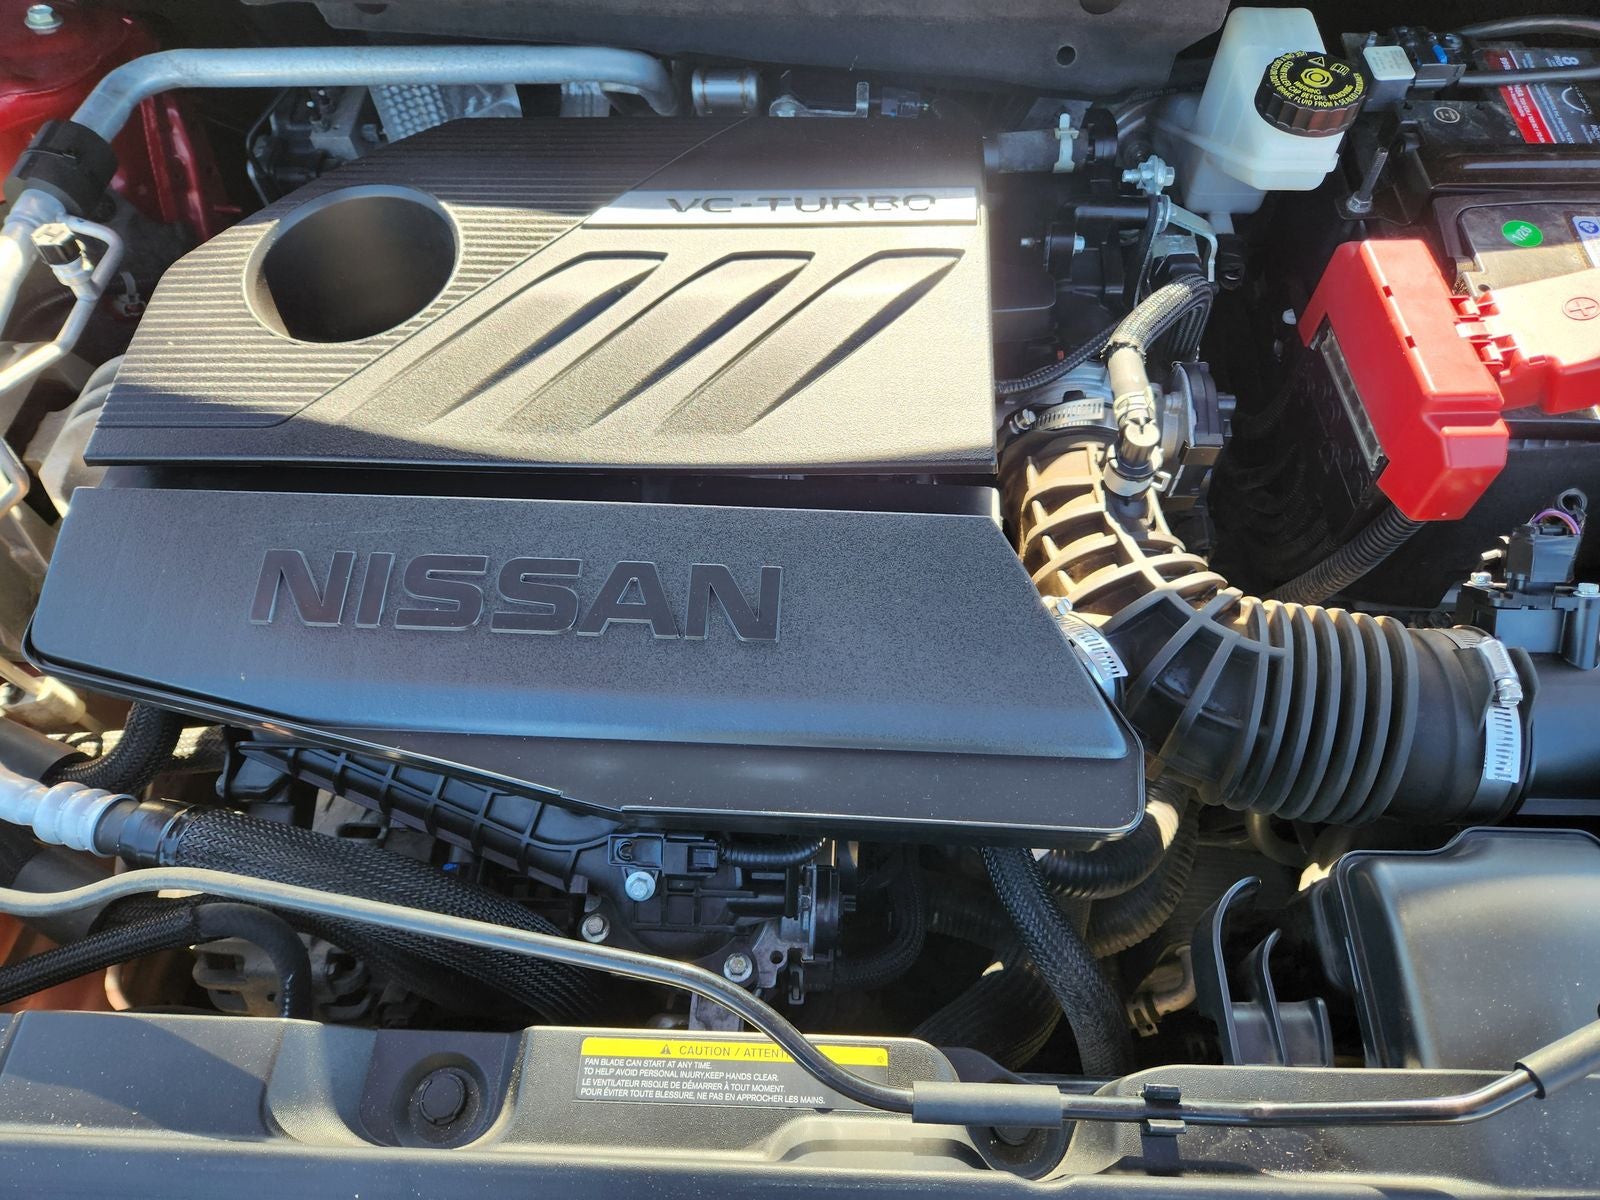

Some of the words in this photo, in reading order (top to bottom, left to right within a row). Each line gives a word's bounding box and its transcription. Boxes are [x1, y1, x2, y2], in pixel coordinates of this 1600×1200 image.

[1288, 86, 1302, 94] CAP
[1300, 91, 1328, 101] BEFORE
[1293, 80, 1321, 95] WARNING
[1293, 96, 1313, 106] FLUID
[1339, 93, 1359, 106] SEALED
[666, 195, 936, 213] VC-TURBO
[250, 548, 784, 643] NISSAN
[679, 1045, 730, 1057] CAUTION
[585, 1058, 599, 1066] FAN
[601, 1058, 624, 1066] BLADE
[626, 1059, 642, 1067] CAN
[643, 1060, 666, 1068] START
[595, 1068, 614, 1076] HELP
[639, 1069, 678, 1078] PERSONAL
[593, 1079, 640, 1087] VENTILATEUR
[641, 1080, 669, 1088] RISQUE
[682, 1081, 722, 1090] DÉMARRER
[724, 1082, 729, 1091] À
[581, 1088, 602, 1096] POUR
[603, 1087, 628, 1097] ÉVITER
[630, 1089, 654, 1097] TOUTE
[709, 1092, 724, 1100] PAS
[737, 1094, 783, 1103] APPROCHER
[800, 1096, 826, 1104] MAINS.
